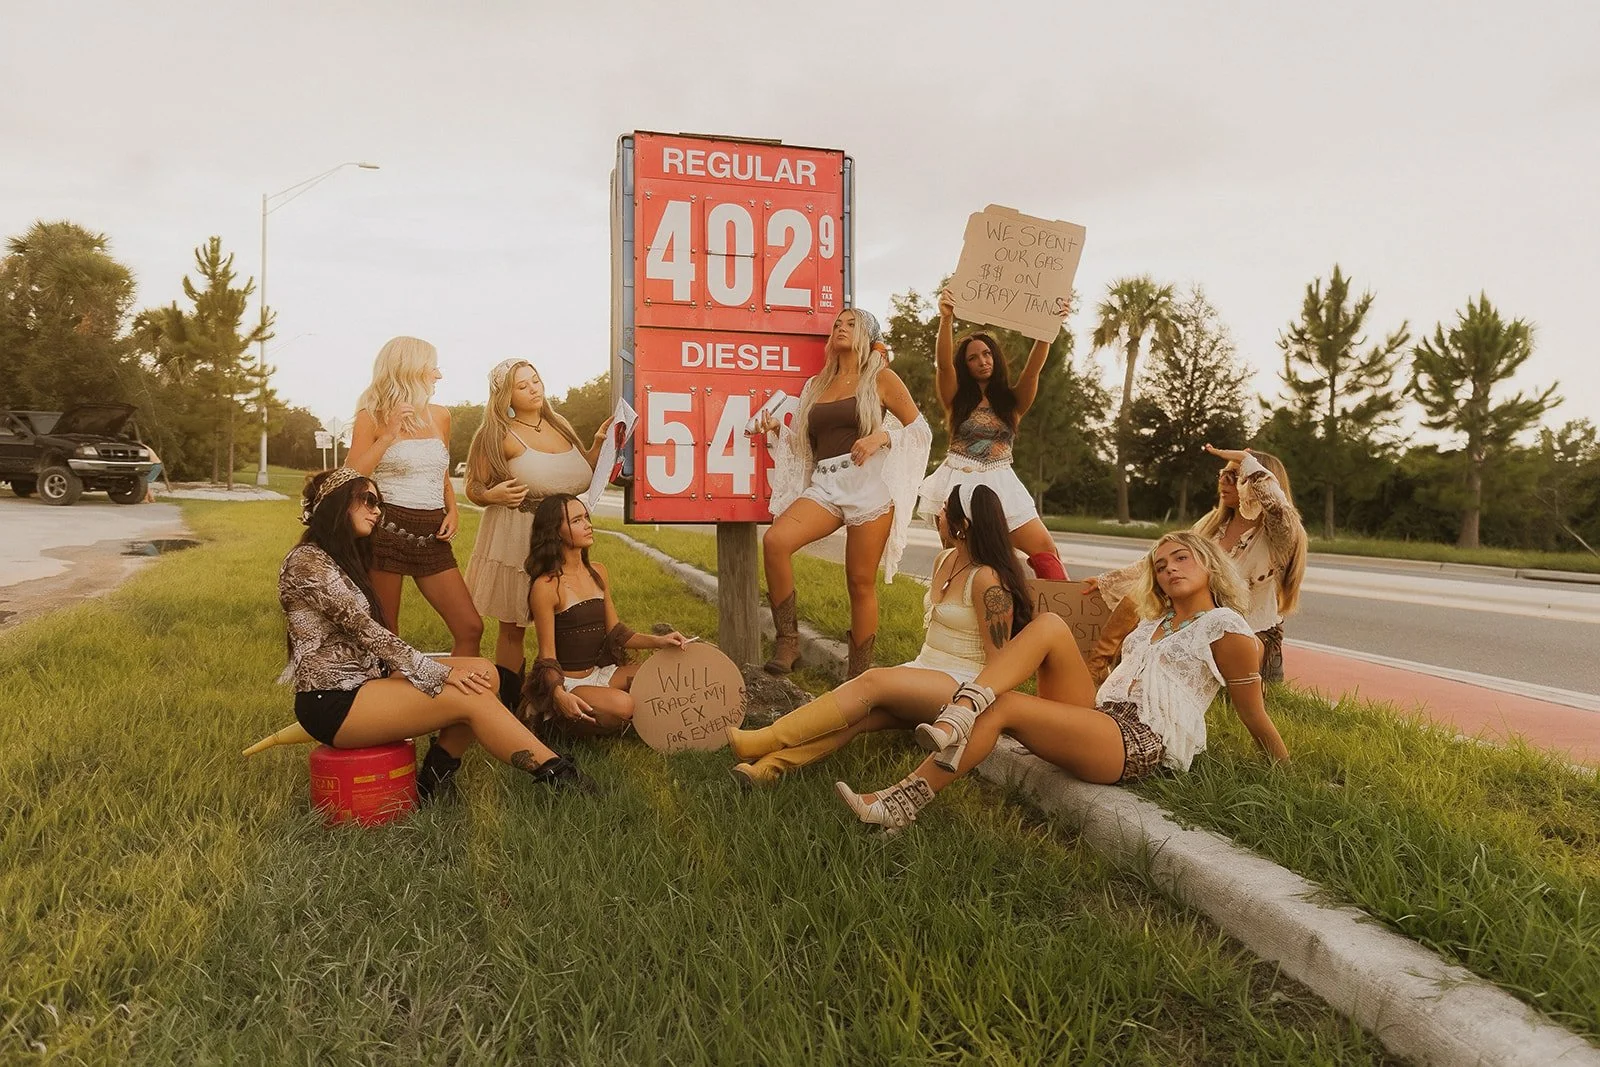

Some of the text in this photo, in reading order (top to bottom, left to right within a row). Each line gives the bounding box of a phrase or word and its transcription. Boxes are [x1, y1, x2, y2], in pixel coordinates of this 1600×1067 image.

[662, 147, 817, 186] REGULAR
[986, 221, 1014, 242] WE
[994, 247, 1064, 271] OUR GAS
[980, 263, 1041, 288] $$ ON
[961, 280, 1064, 316] SPRAY TANS
[682, 341, 801, 372] DIESEL
[1080, 596, 1103, 617] IS
[657, 663, 719, 693] WILL
[644, 685, 726, 716] TRADE MY
[681, 705, 705, 727] EX
